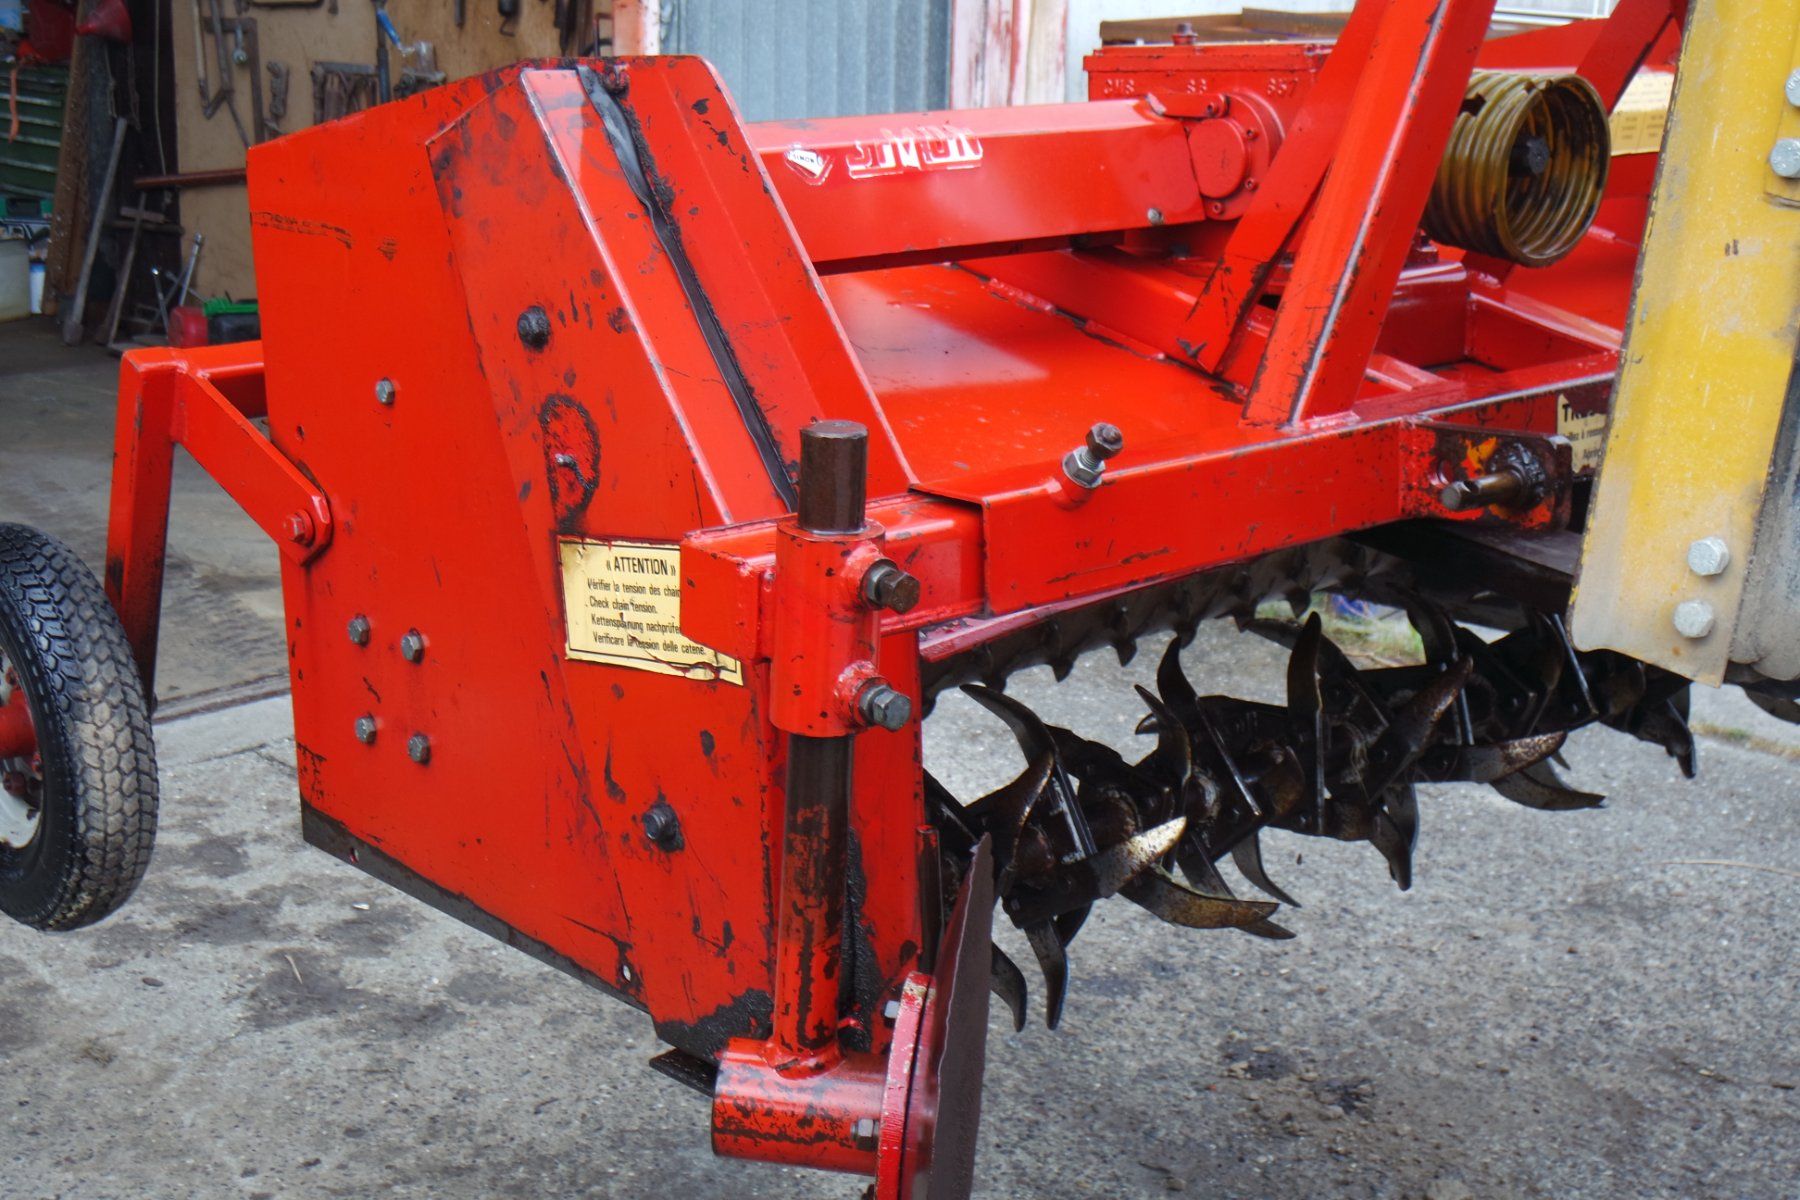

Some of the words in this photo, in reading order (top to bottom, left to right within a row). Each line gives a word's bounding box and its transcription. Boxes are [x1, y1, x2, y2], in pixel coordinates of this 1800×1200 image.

[614, 556, 669, 576] ATTENTION
[613, 580, 620, 592] la
[622, 582, 647, 594] tension
[649, 584, 661, 596] des
[589, 595, 609, 609] Check
[612, 597, 629, 611] chain
[593, 631, 625, 647] Verificare
[662, 640, 679, 654] delle
